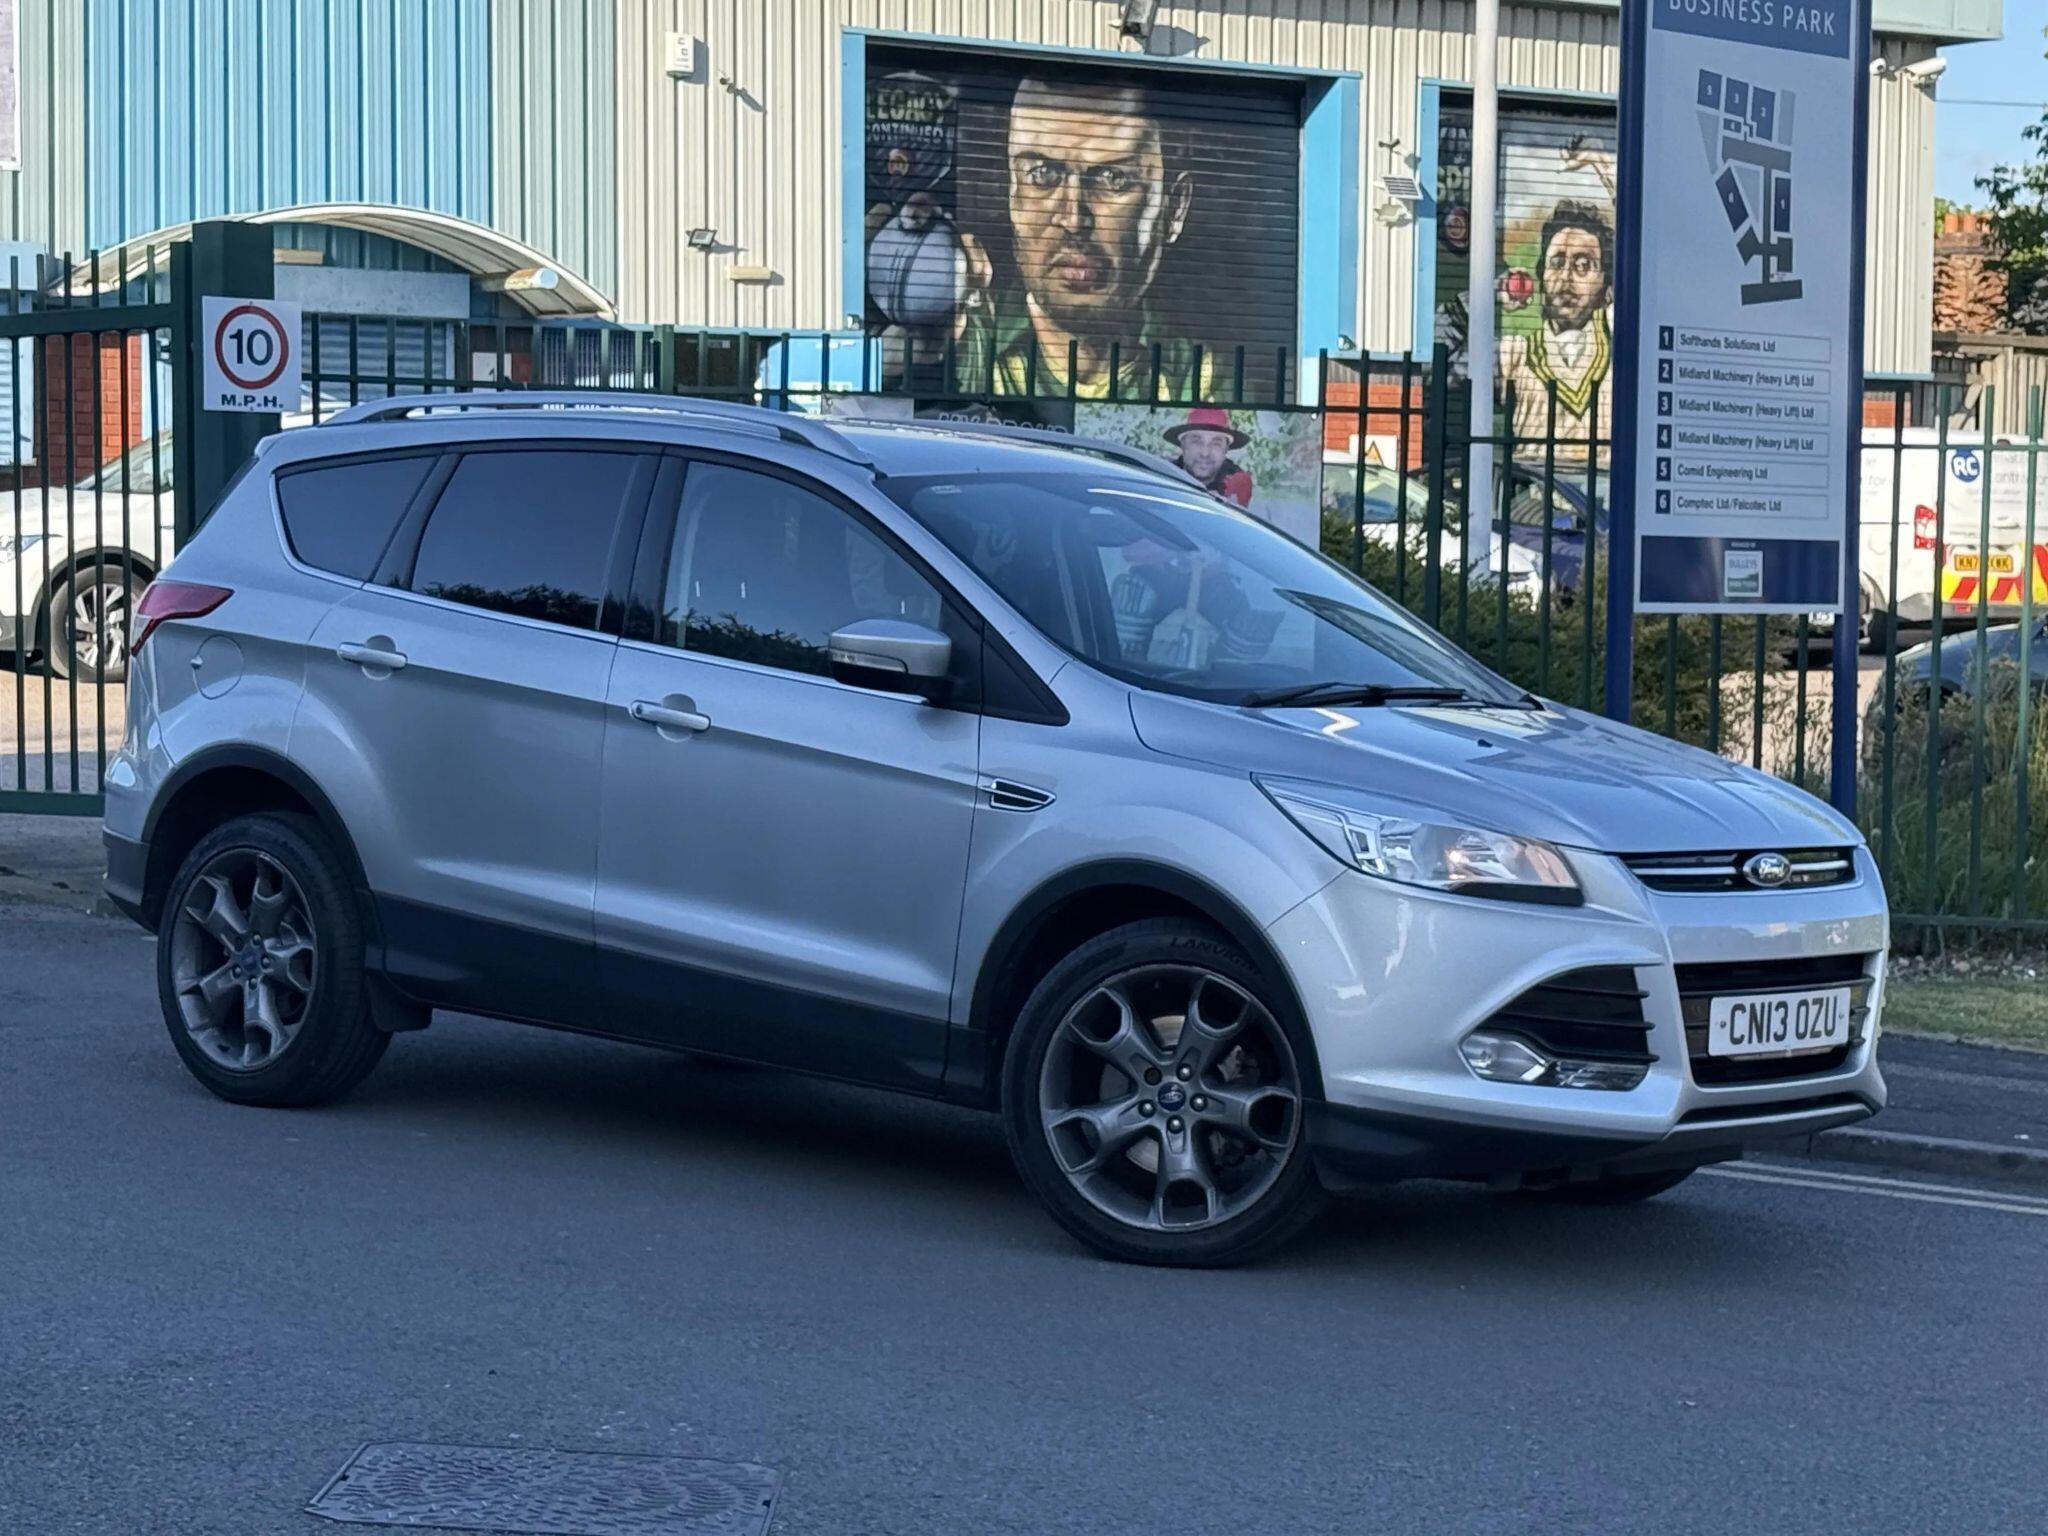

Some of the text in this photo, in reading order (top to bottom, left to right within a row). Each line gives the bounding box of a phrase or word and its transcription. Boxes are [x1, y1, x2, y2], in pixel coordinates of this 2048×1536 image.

[1782, 5, 1836, 36] PARK
[229, 328, 273, 366] 10
[1662, 331, 1670, 347] 1
[1724, 336, 1761, 352] Solutions
[1763, 340, 1776, 353] Ltd
[1661, 363, 1815, 389] 2 Midland Machinery (Heavy Lift) Ltd
[221, 394, 284, 408] M.P.H.
[1660, 396, 1814, 419] 3 Midland Machinery (Heavy Lift) Ltd
[1660, 429, 1814, 451] 4 Midland Machinery (Heavy Lift) Ltd
[1659, 461, 1768, 481] 5 Comid Engineering Ltd
[1953, 457, 1978, 476] RC
[1658, 494, 1667, 510] 6
[1677, 496, 1713, 512] Comptec
[1769, 500, 1782, 512] Ltd
[1729, 996, 1838, 1046] CN13 OZU
